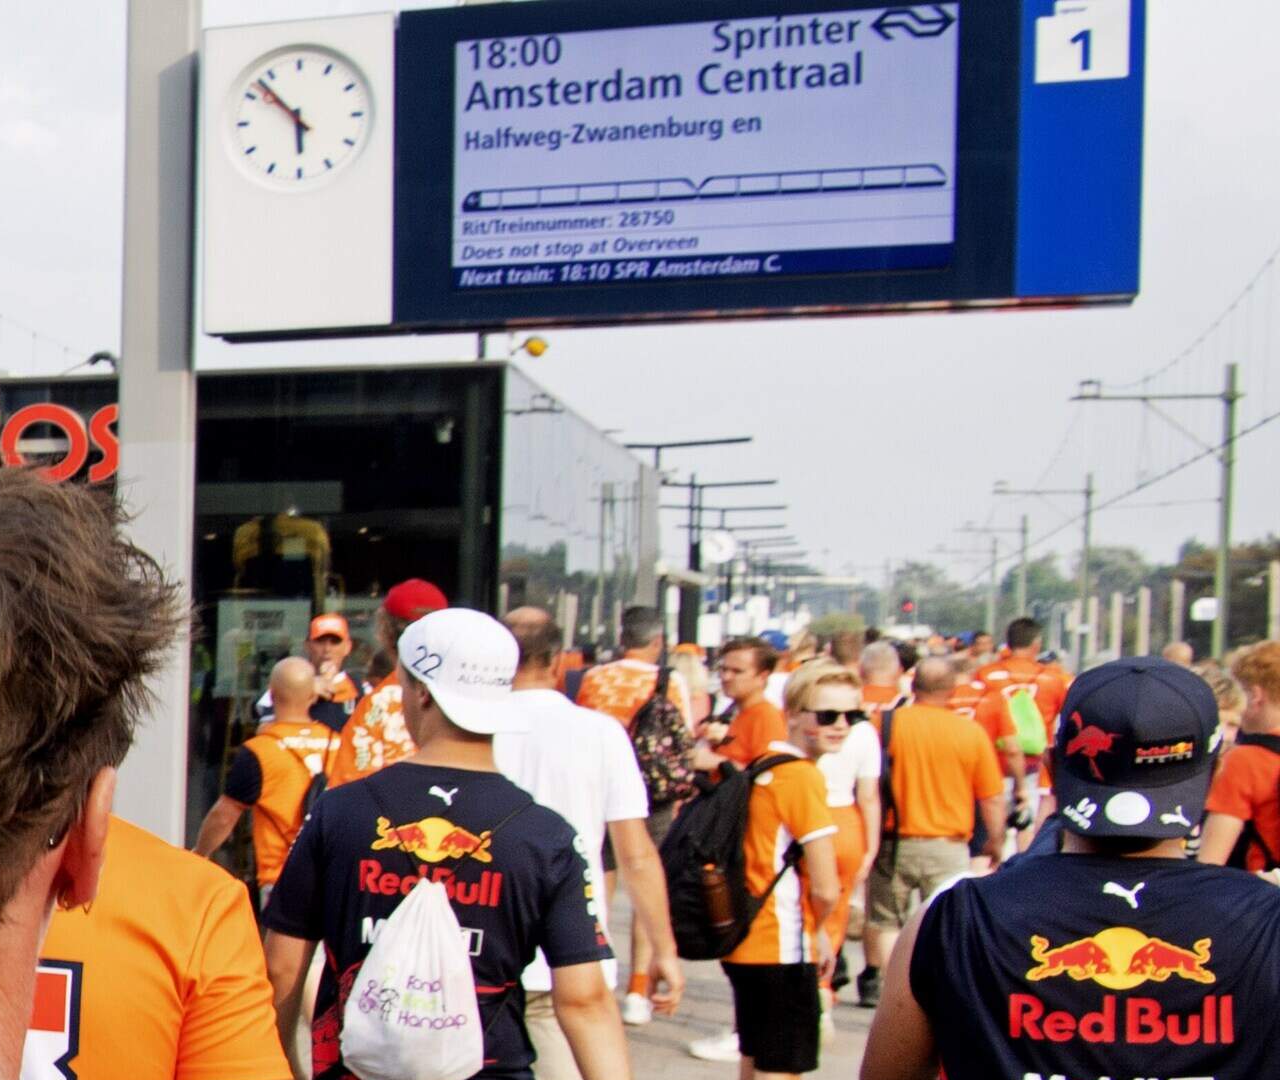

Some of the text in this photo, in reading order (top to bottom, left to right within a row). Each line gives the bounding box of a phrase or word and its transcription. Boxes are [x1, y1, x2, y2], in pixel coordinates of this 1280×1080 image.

[466, 16, 862, 70] 18:00 Sprinter
[1070, 28, 1091, 71] 1
[464, 51, 863, 112] Amsterdam Centraal
[464, 114, 762, 151] Halfweg-Zwanenburg en
[462, 210, 675, 235] Rit/Treinnummer: 28750
[462, 235, 698, 261] Does not stop at Overveen
[460, 254, 782, 286] Next train: 18:10 SPR Amsterdam C.
[411, 645, 442, 679] 22
[1009, 993, 1234, 1046] Red Bull
